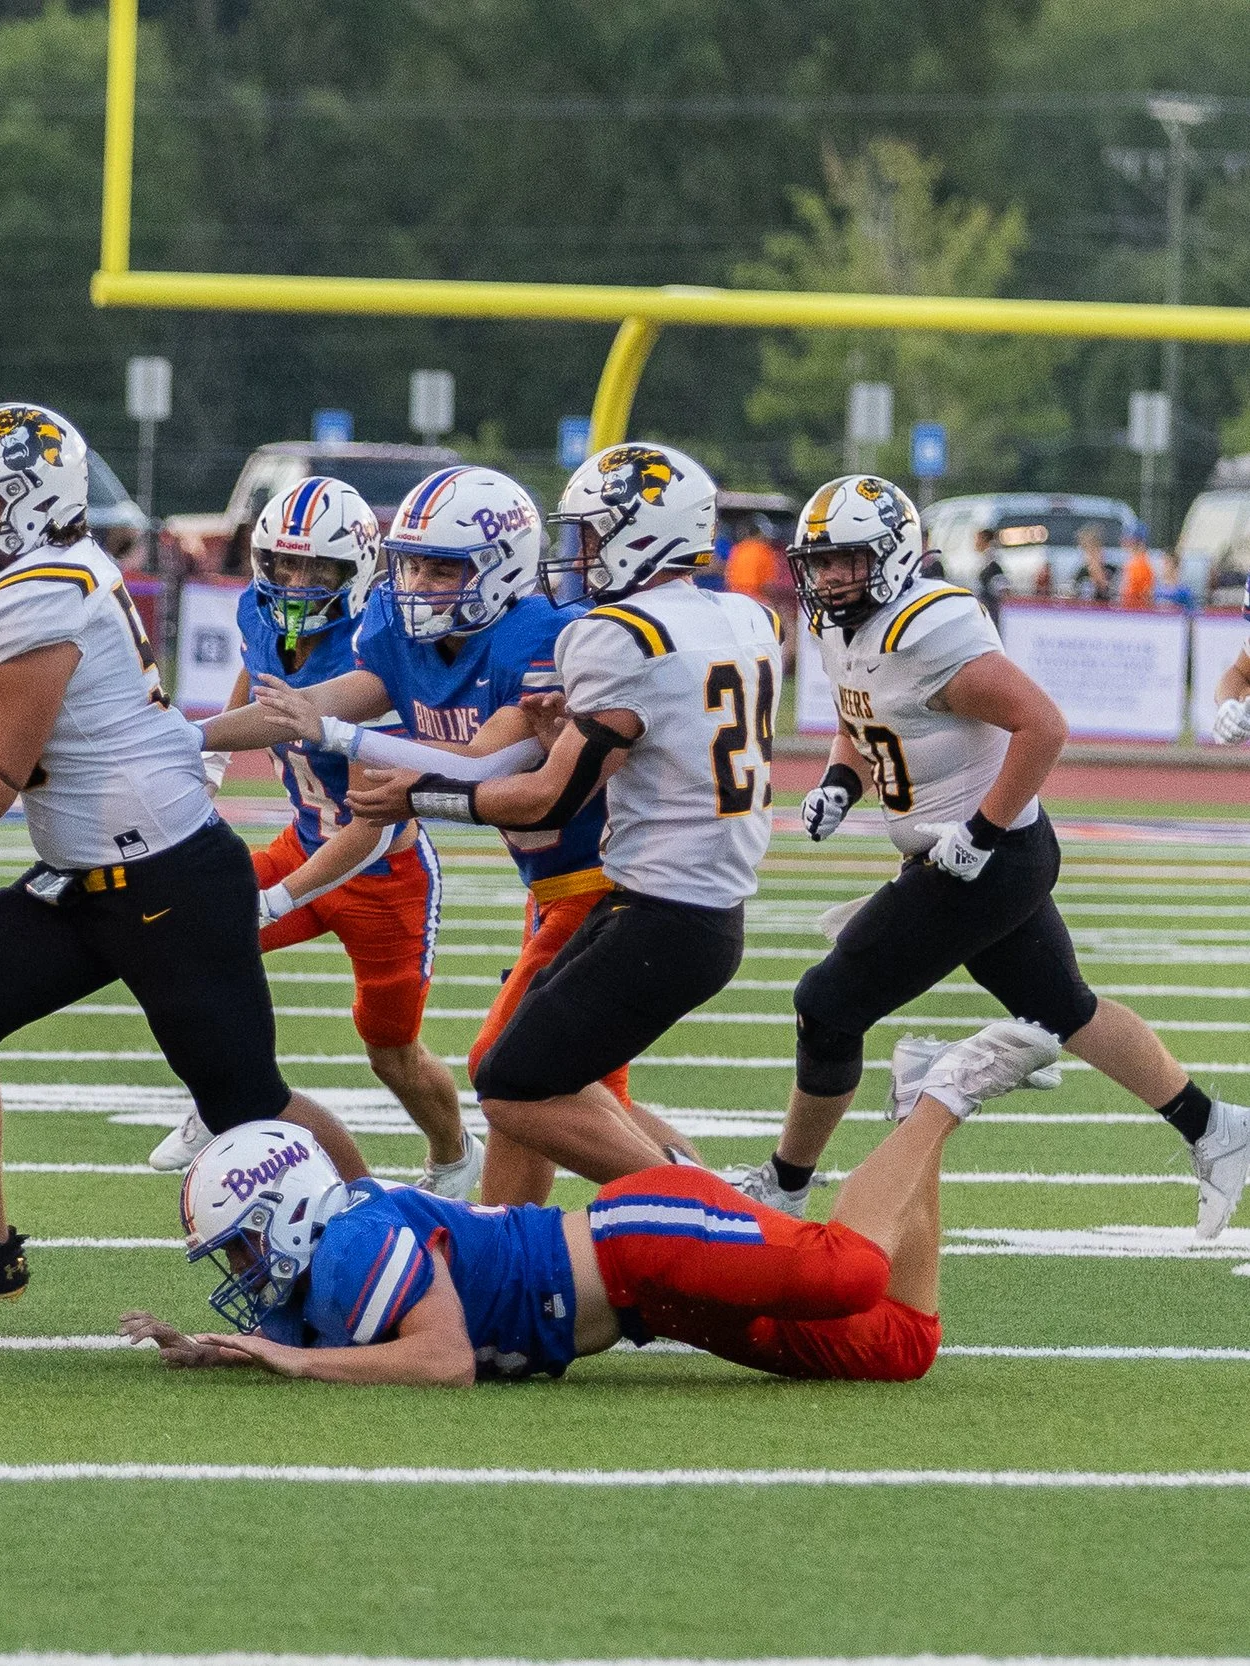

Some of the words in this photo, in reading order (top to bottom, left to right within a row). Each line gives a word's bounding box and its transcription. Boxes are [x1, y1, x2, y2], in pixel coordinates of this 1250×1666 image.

[276, 539, 311, 552] Riddell
[412, 698, 481, 742] BRUINS
[123, 835, 133, 843] L
[954, 843, 979, 863] adidas
[221, 1140, 310, 1203] Bruins
[544, 1298, 554, 1313] XL
